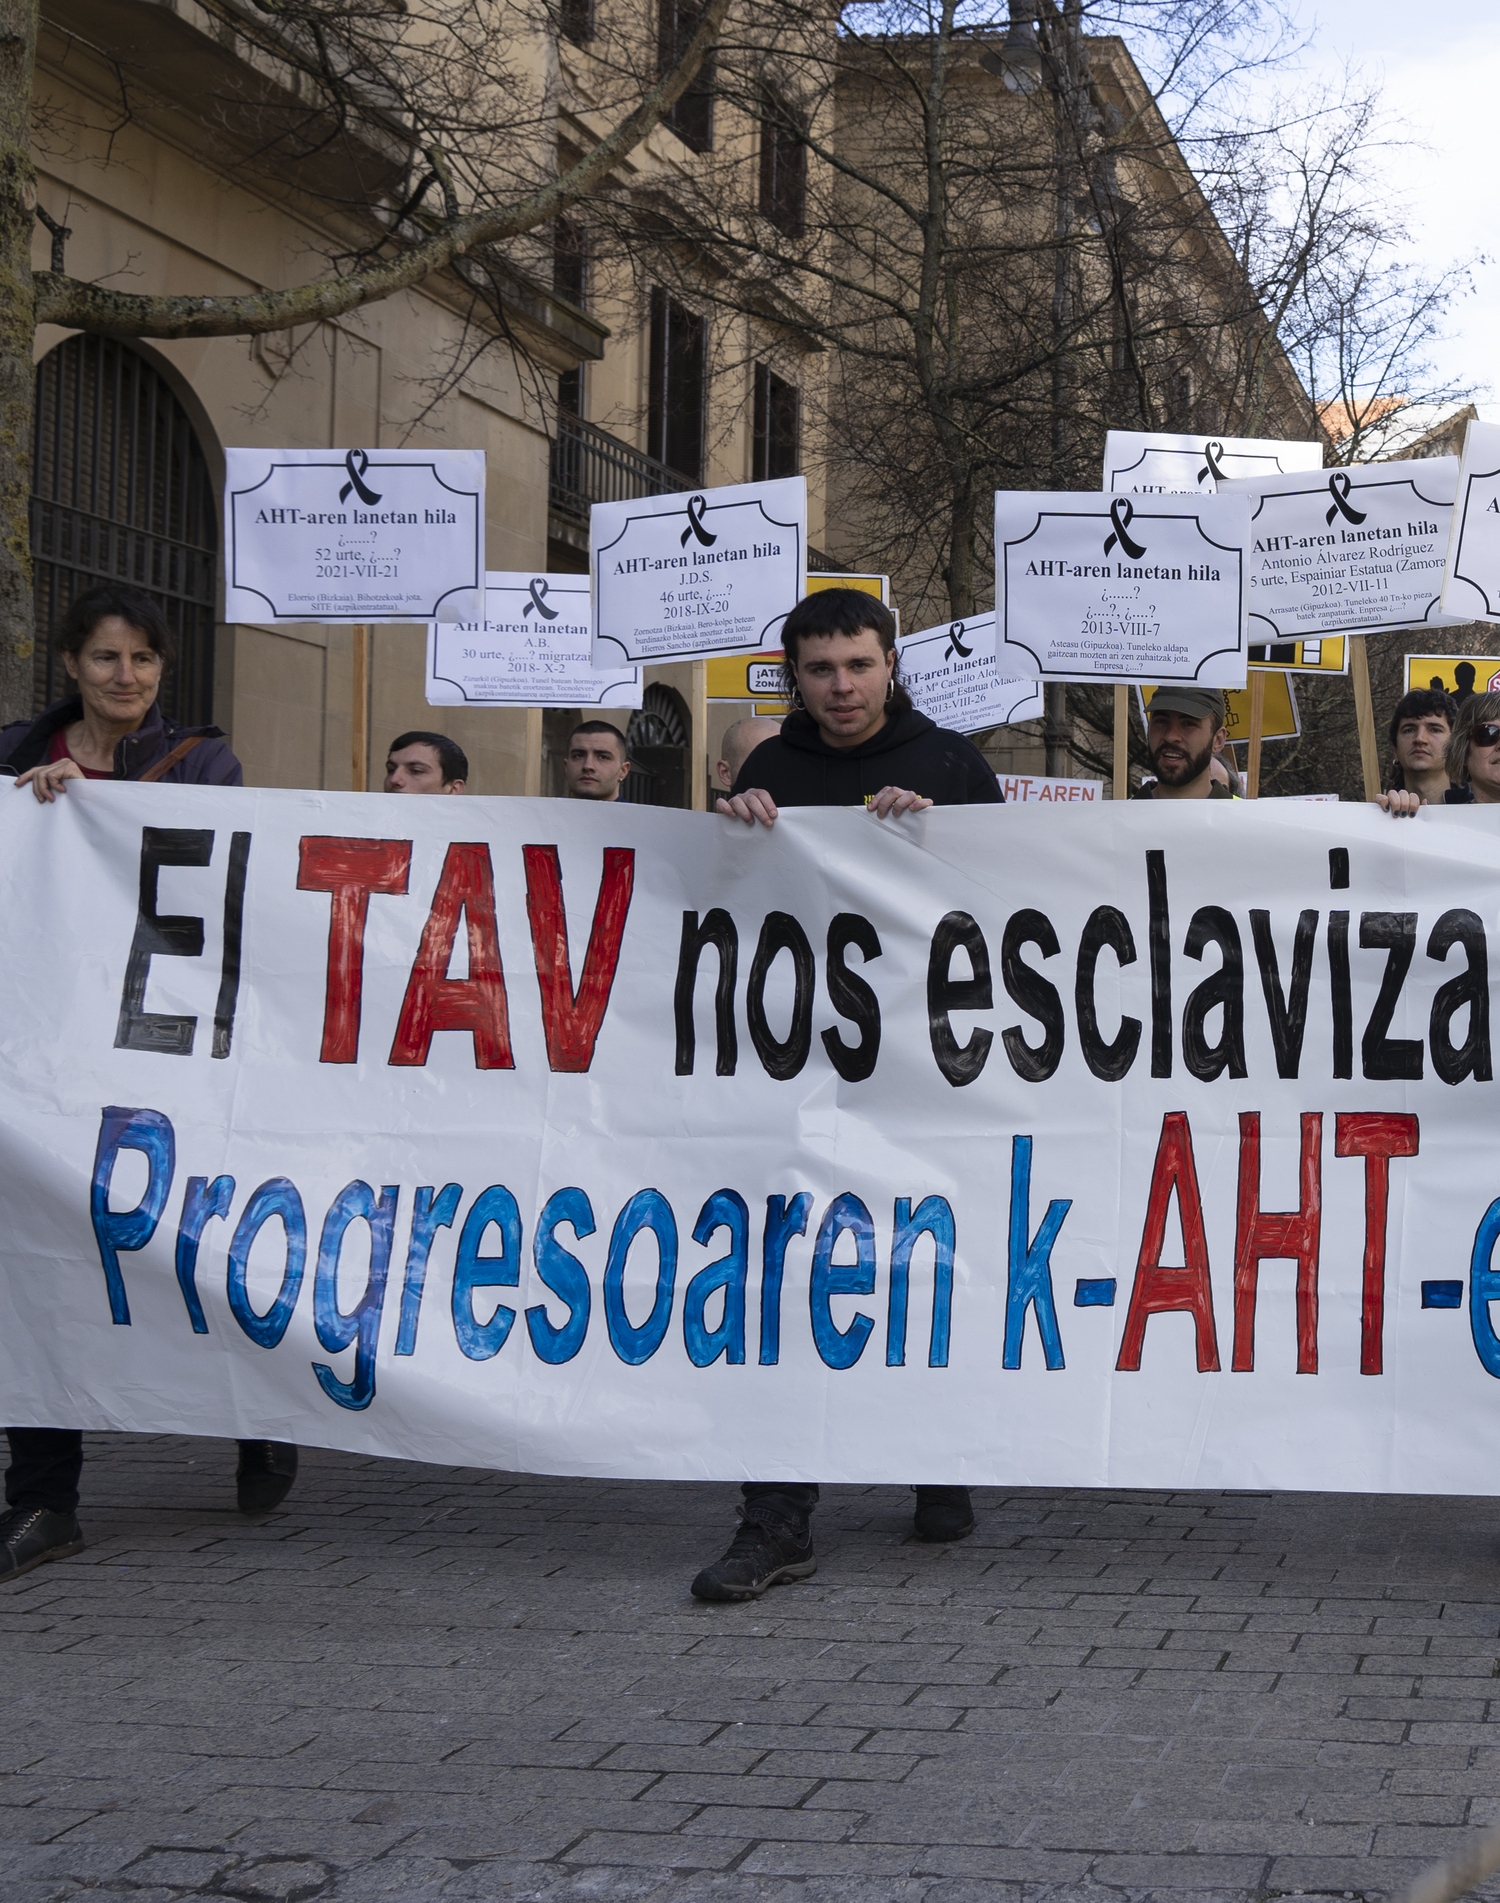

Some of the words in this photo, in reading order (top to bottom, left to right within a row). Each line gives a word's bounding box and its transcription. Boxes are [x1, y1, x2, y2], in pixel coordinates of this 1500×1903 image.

[255, 508, 347, 524] AHT-aren
[353, 509, 417, 524] lanetan
[424, 508, 456, 524] hila
[1252, 534, 1336, 553] AHT-aren
[1341, 527, 1402, 543] lanetan
[1408, 521, 1438, 536] hila
[314, 548, 331, 561] 52
[335, 550, 365, 561] urte,
[613, 556, 688, 575] AHT-aren
[692, 549, 747, 566] lanetan
[753, 542, 781, 558] hila
[1261, 554, 1312, 570] Antonio
[1316, 551, 1365, 564] Álvarez
[1369, 543, 1434, 559] Rodríguez
[315, 565, 398, 578] 2021-VII-21
[679, 570, 712, 585] J.D.S.
[1025, 560, 1111, 578] AHT-aren
[1117, 562, 1181, 580] lanetan
[1188, 564, 1220, 581] hila
[1250, 575, 1257, 588] 5
[1260, 575, 1288, 586] urte,
[1291, 567, 1346, 585] Espainiar
[1350, 564, 1393, 576] Estatua
[659, 590, 674, 603] 46
[677, 590, 703, 602] urte,
[1311, 577, 1388, 597] 2012-VII-11
[663, 600, 729, 619] 2018-IX-20
[1268, 606, 1298, 615] Arrasate
[1343, 596, 1378, 606] Tuneleko
[1390, 593, 1412, 601] Tn-ko
[1413, 592, 1432, 601] pieza
[1296, 611, 1316, 620] batek
[1358, 605, 1388, 615] Enpresa
[534, 621, 587, 634] lanetan
[633, 627, 663, 636] Zornotza
[697, 617, 733, 629] Bero-kolpe
[733, 616, 755, 624] betean
[1080, 620, 1160, 636] 2013-VIII-7
[523, 637, 550, 648] A.B.
[634, 634, 671, 644] burdinazko
[672, 630, 698, 640] blokeak
[699, 628, 723, 637] moztuz
[461, 648, 476, 658] 30
[479, 651, 505, 660] urte,
[538, 650, 592, 664] migratzai
[641, 644, 665, 653] Hierros
[666, 640, 691, 650] Sancho
[1047, 650, 1078, 659] gaitzean
[1108, 651, 1119, 660] ari
[1135, 652, 1172, 662] zuhaitzak
[1049, 639, 1079, 648] Asteasu
[1126, 642, 1162, 651] Tuneleko
[1163, 643, 1188, 654] aldapa
[902, 667, 949, 686] HT-aren
[953, 655, 996, 673] lanetan
[1094, 660, 1123, 671] Enpresa
[925, 681, 938, 693] Mª
[940, 673, 975, 689] Castillo
[976, 669, 999, 680] Alo
[914, 690, 955, 708] Espainiar
[957, 682, 988, 696] Estatua
[924, 693, 986, 717] 2013-VIII-26
[1003, 778, 1095, 802] HT-AREN
[114, 827, 252, 1060] El
[296, 835, 636, 1075] TAV
[674, 907, 883, 1083] nos
[926, 846, 1493, 1088] esclaviza
[90, 1106, 957, 1411] Progresoaren
